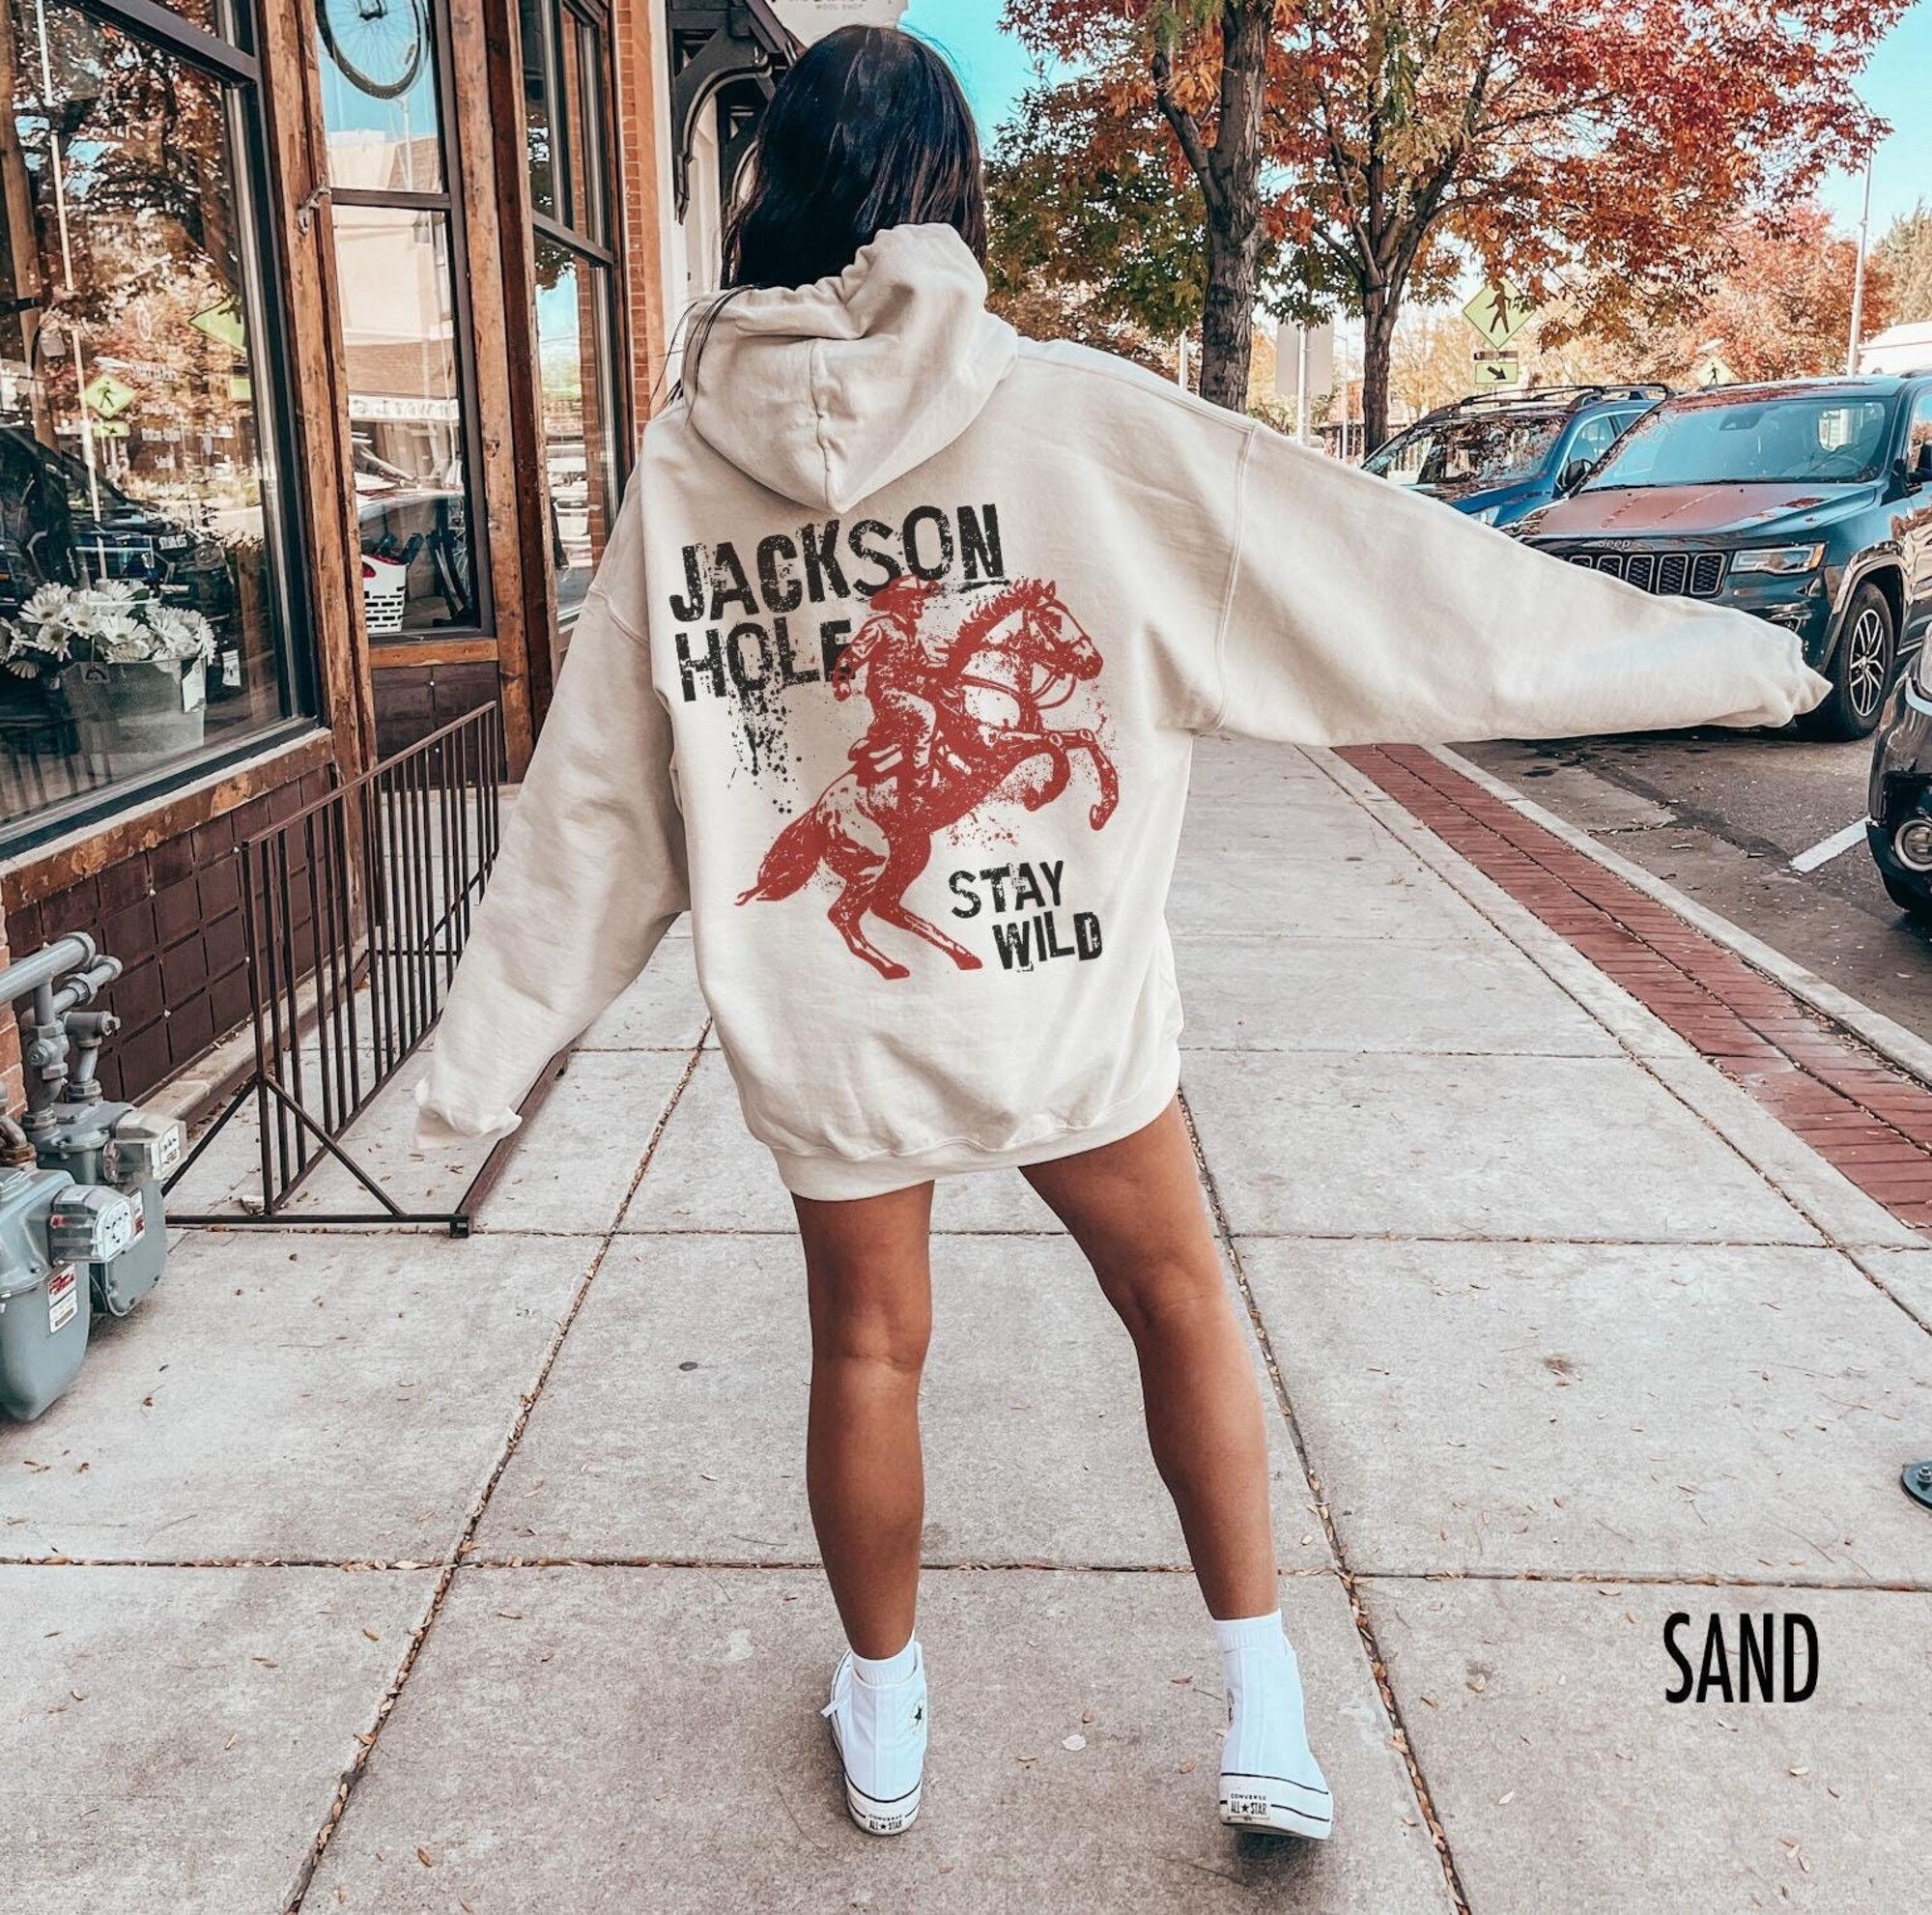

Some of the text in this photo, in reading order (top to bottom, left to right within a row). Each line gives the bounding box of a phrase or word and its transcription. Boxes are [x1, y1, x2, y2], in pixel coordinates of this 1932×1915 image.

[669, 503, 1005, 622] JACKSON
[1598, 538, 1632, 550] Jeep
[949, 861, 1064, 919] STAY
[992, 911, 1103, 971] WILD
[1251, 1802, 1267, 1815] STAR
